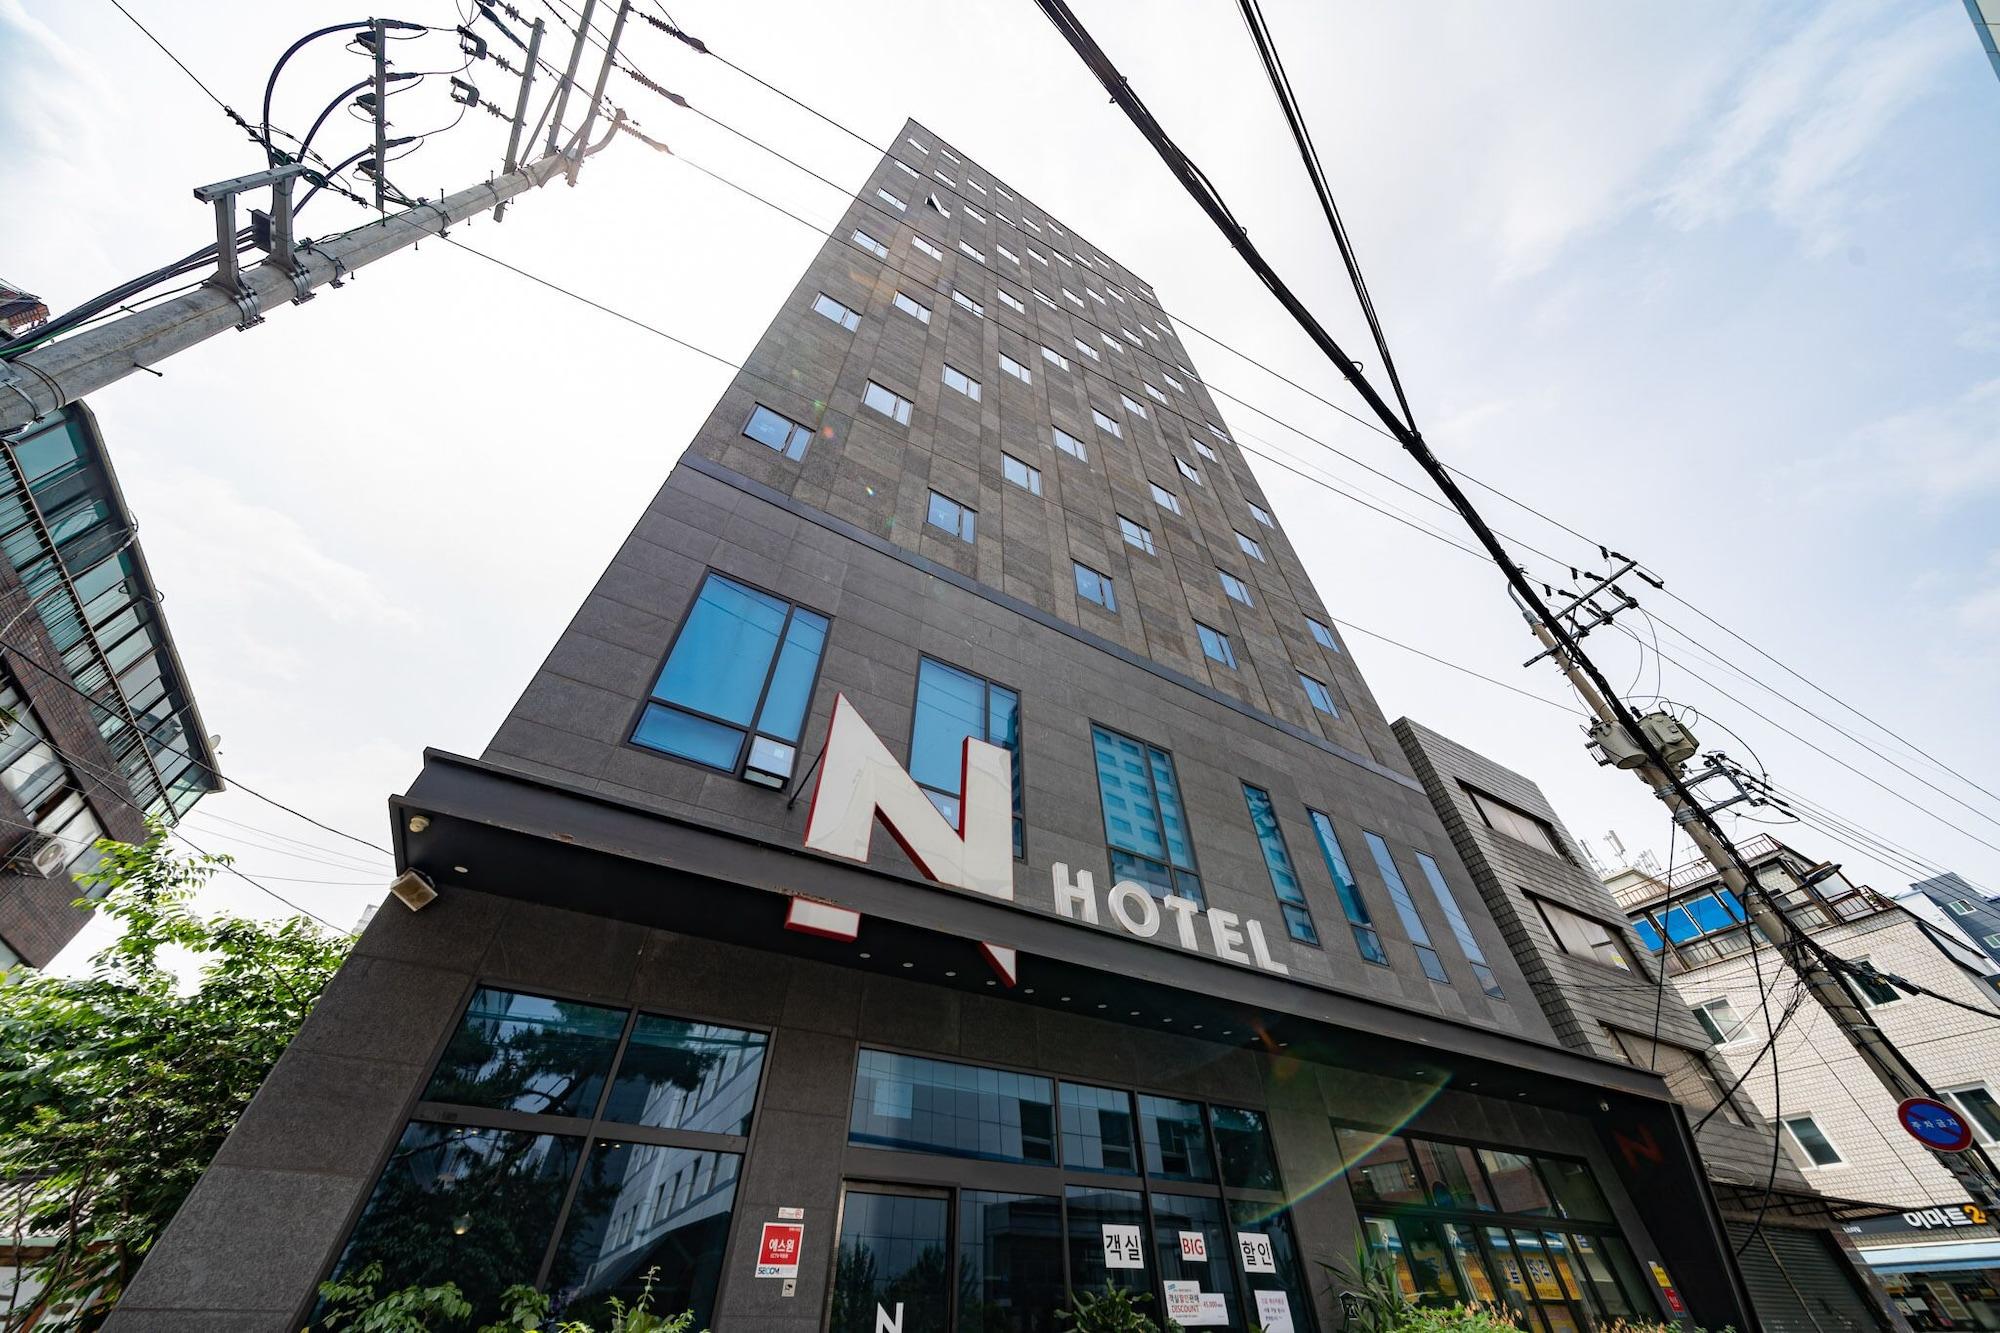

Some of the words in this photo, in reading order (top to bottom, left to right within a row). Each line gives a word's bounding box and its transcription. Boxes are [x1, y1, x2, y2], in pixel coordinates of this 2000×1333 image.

[784, 692, 1016, 987] N
[1051, 861, 1289, 975] HOTEL
[1911, 1118, 1959, 1129] 주차금지
[769, 1238, 795, 1253] 에스원
[1105, 1234, 1141, 1261] 객실
[1182, 1237, 1204, 1255] BIG
[1241, 1240, 1272, 1266] 할인
[758, 1266, 780, 1275] SECOM
[1171, 1304, 1199, 1312] DISCOUNT
[875, 1302, 904, 1333] N
